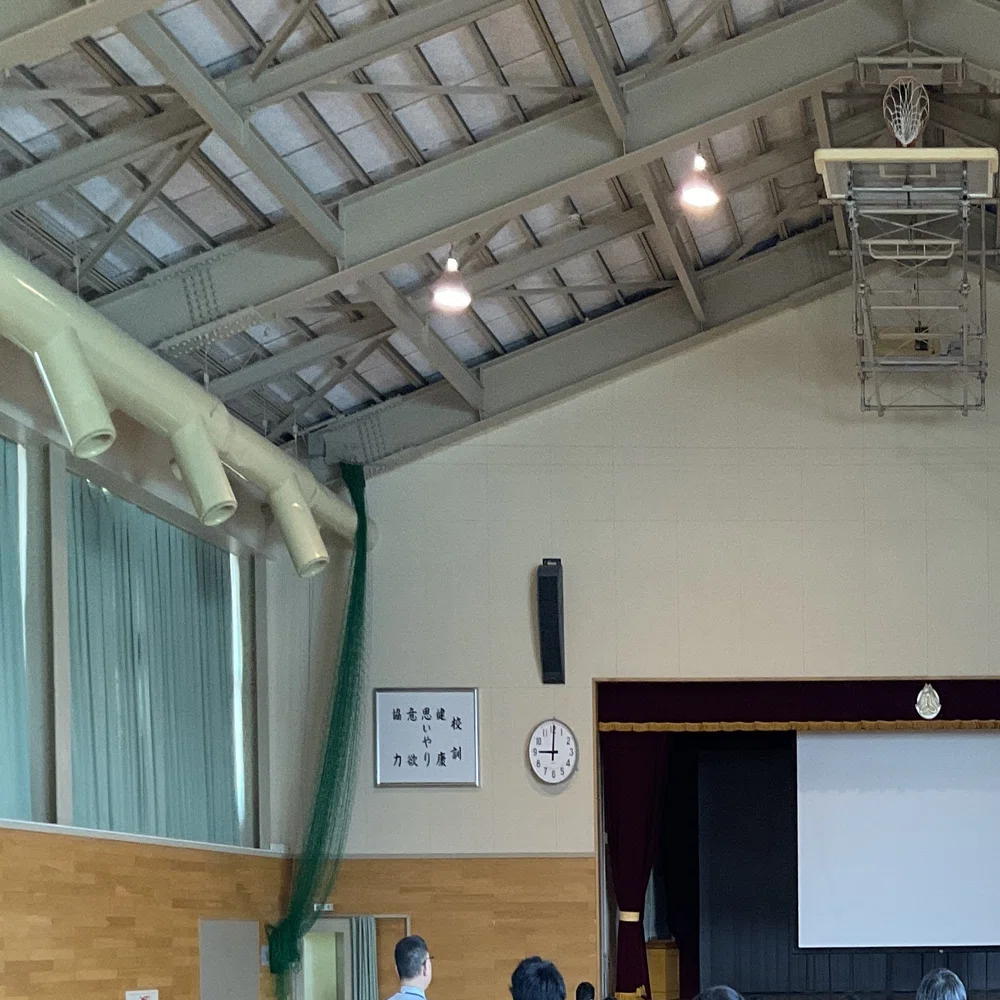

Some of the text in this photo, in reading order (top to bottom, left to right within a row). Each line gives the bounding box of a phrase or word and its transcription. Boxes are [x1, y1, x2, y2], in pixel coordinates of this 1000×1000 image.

[392, 708, 402, 767] 協力
[406, 707, 419, 767] 意欲
[421, 707, 432, 767] 思いやり
[436, 707, 447, 767] 健康
[450, 716, 463, 761] 校訓
